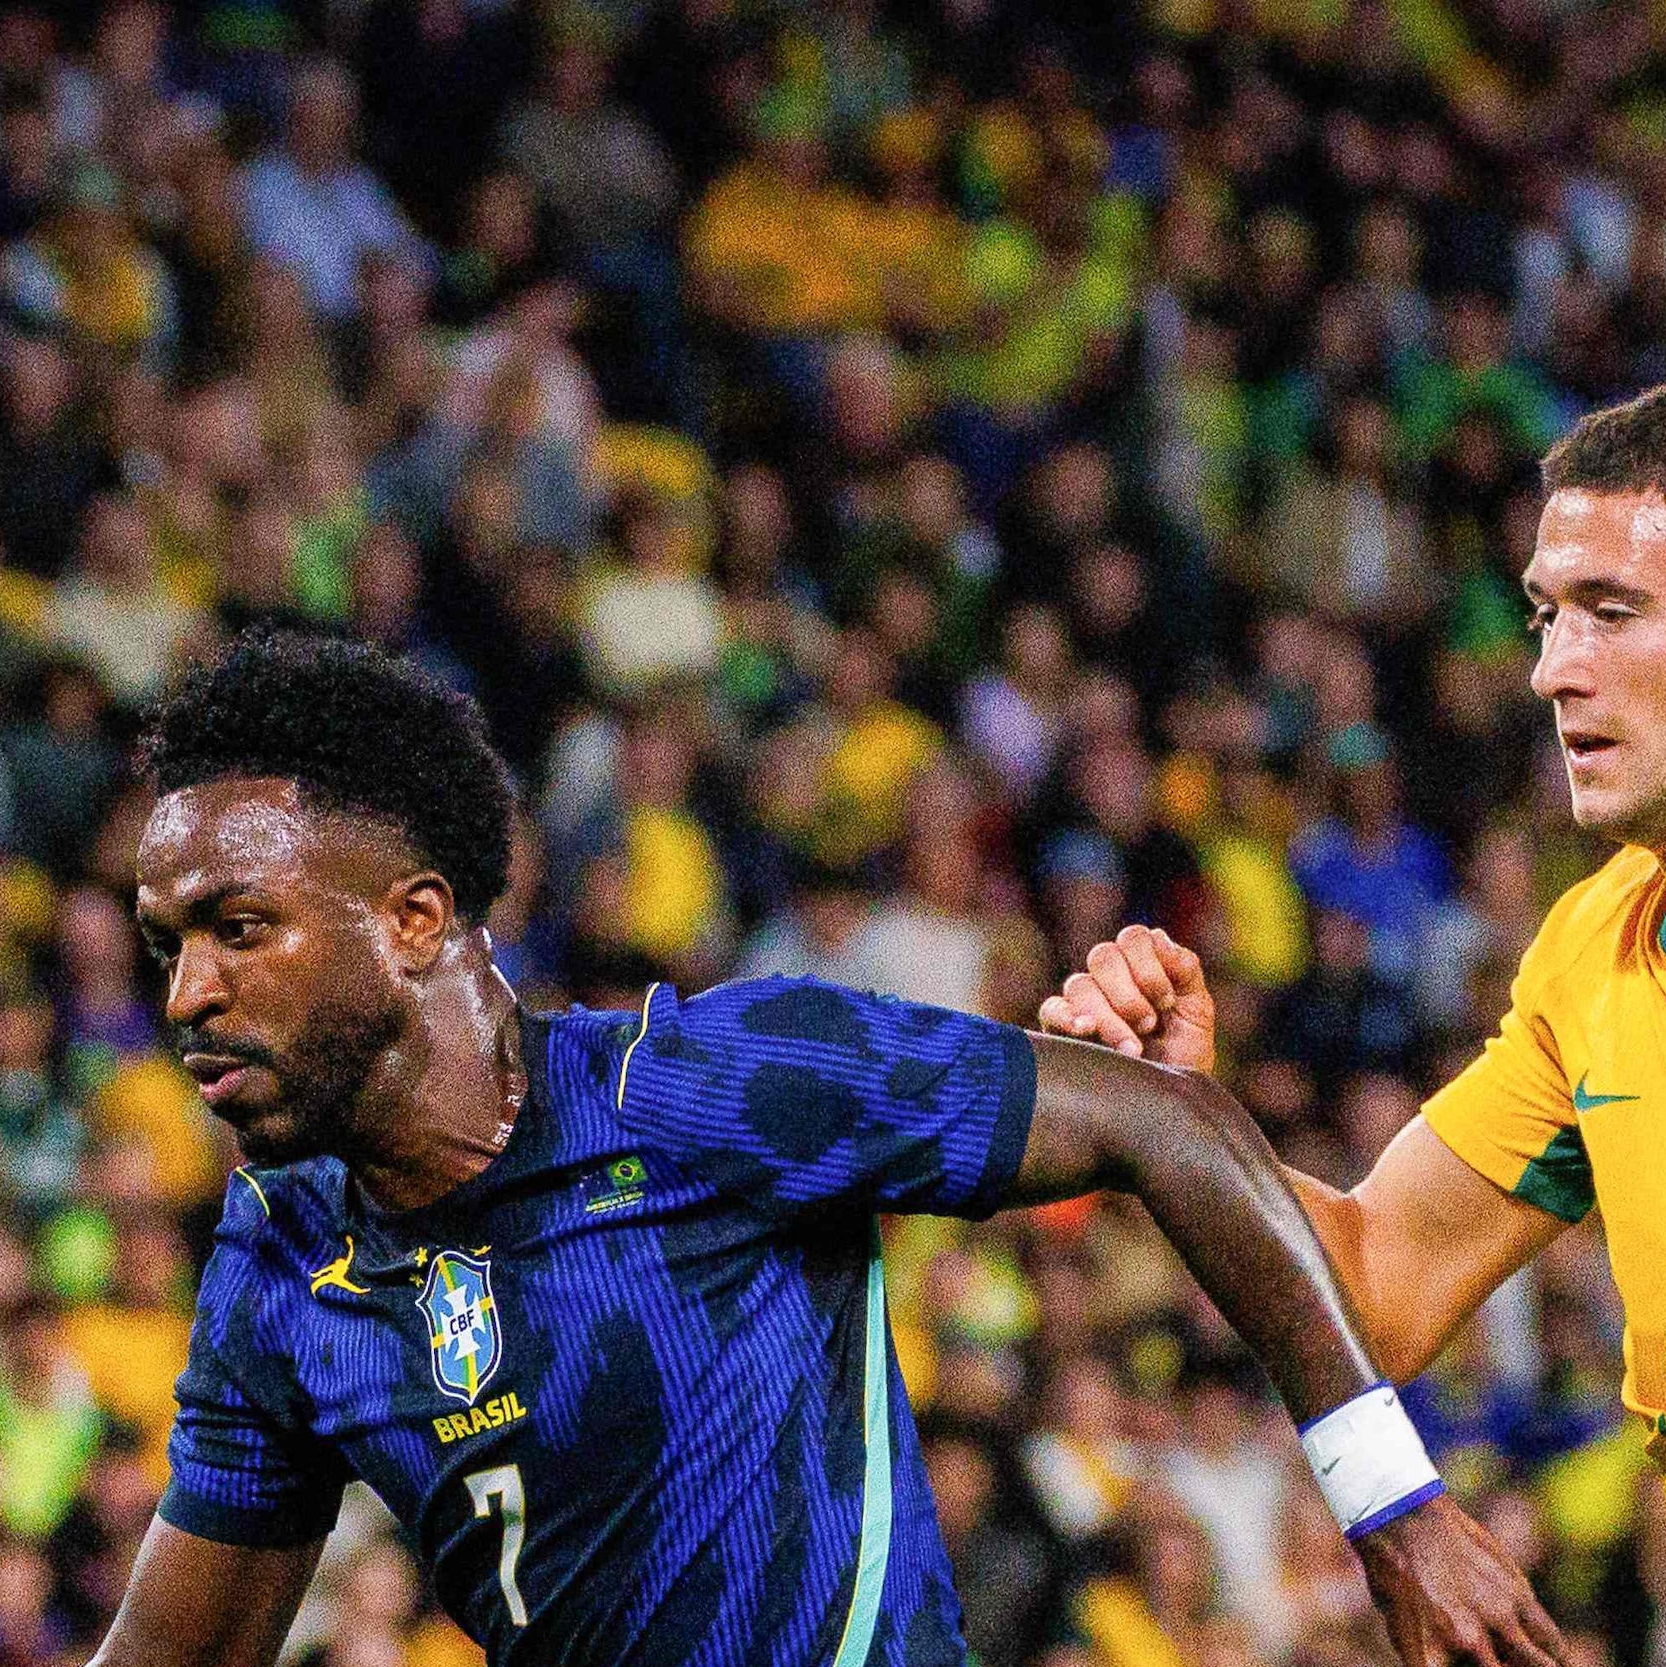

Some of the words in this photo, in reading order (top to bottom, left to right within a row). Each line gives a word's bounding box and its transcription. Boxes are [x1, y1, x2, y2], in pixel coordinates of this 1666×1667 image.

[449, 1309, 476, 1335] CBF
[432, 1391, 527, 1444] BRASIL
[463, 1463, 529, 1629] 7
